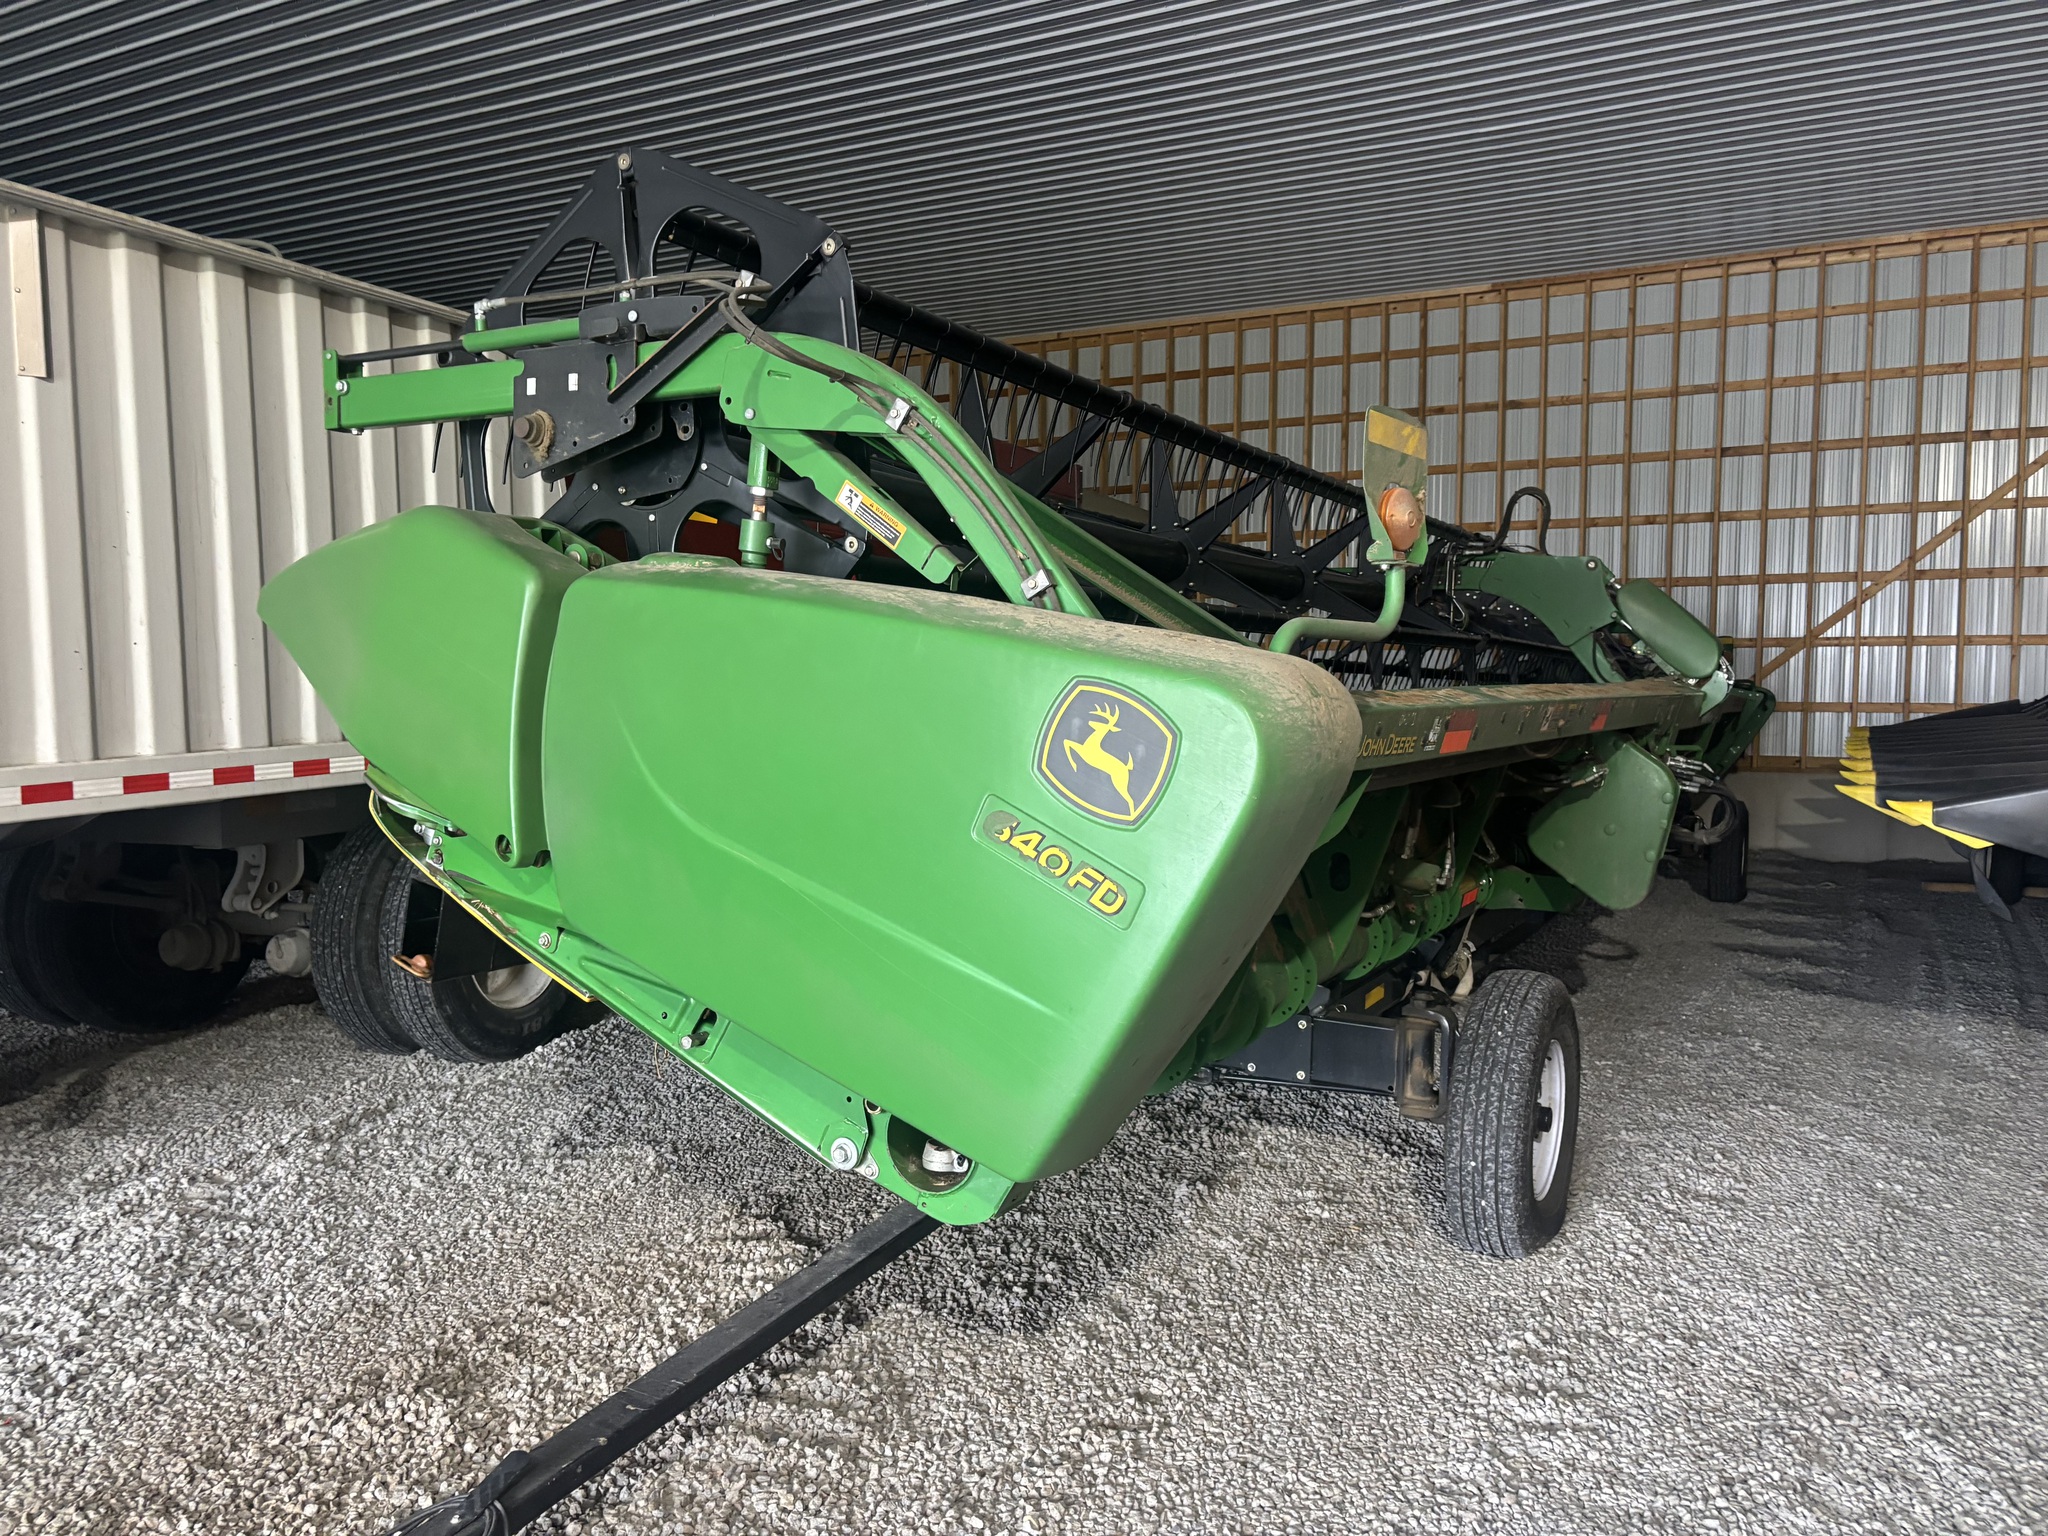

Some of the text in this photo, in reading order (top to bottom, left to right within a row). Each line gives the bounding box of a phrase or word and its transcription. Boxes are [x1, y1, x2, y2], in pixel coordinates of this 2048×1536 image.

[875, 507, 900, 528] WARNING
[1359, 735, 1385, 757] JOHN
[1385, 733, 1418, 755] DEERE
[1064, 861, 1128, 917] FD
